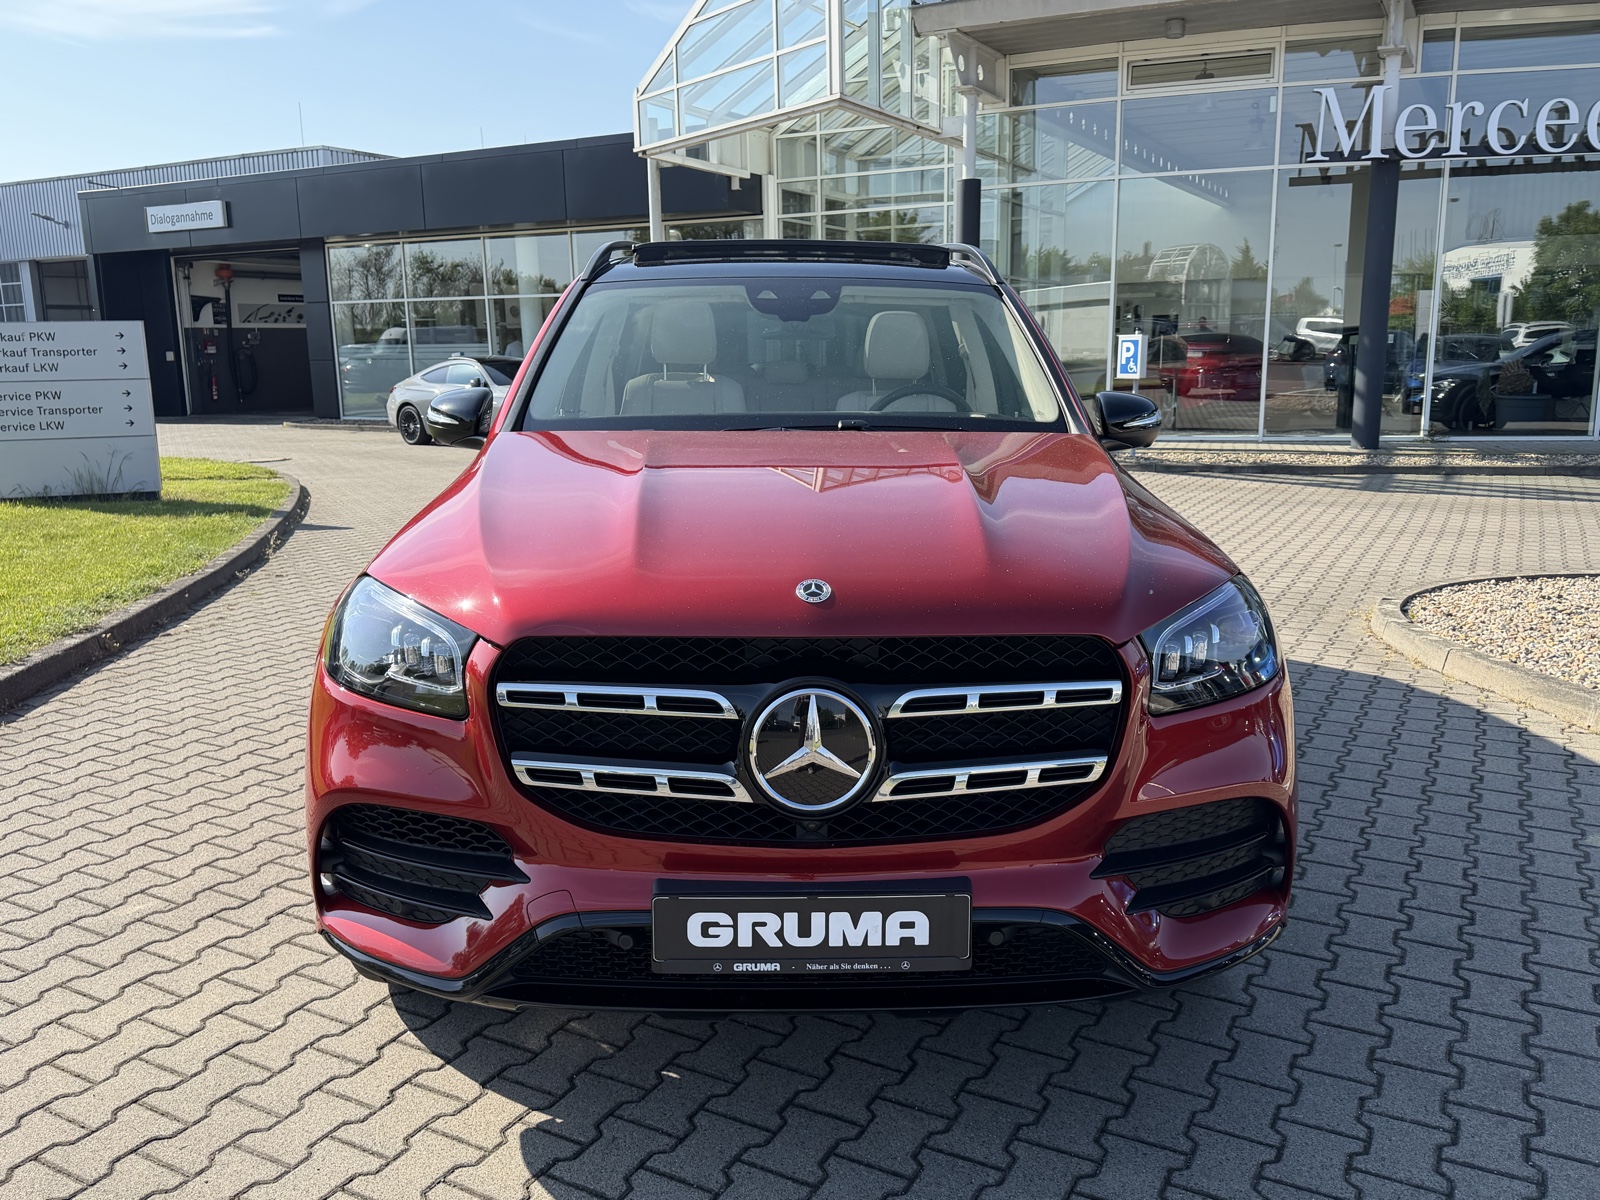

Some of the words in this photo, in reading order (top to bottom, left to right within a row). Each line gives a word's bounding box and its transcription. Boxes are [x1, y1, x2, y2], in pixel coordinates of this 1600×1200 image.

[150, 210, 214, 227] Dialogannahme
[29, 331, 56, 342] PKW
[0, 347, 27, 357] kauf
[31, 346, 98, 359] Transporter
[1121, 341, 1135, 365] P
[33, 362, 59, 372] LKW
[35, 390, 62, 400] PKW
[37, 405, 104, 417] Transporter
[39, 420, 65, 431] LKW
[687, 910, 930, 948] GRUMA
[733, 962, 781, 972] GRUMA
[806, 963, 828, 971] Näher
[840, 962, 852, 970] Sie
[853, 962, 879, 970] denken
